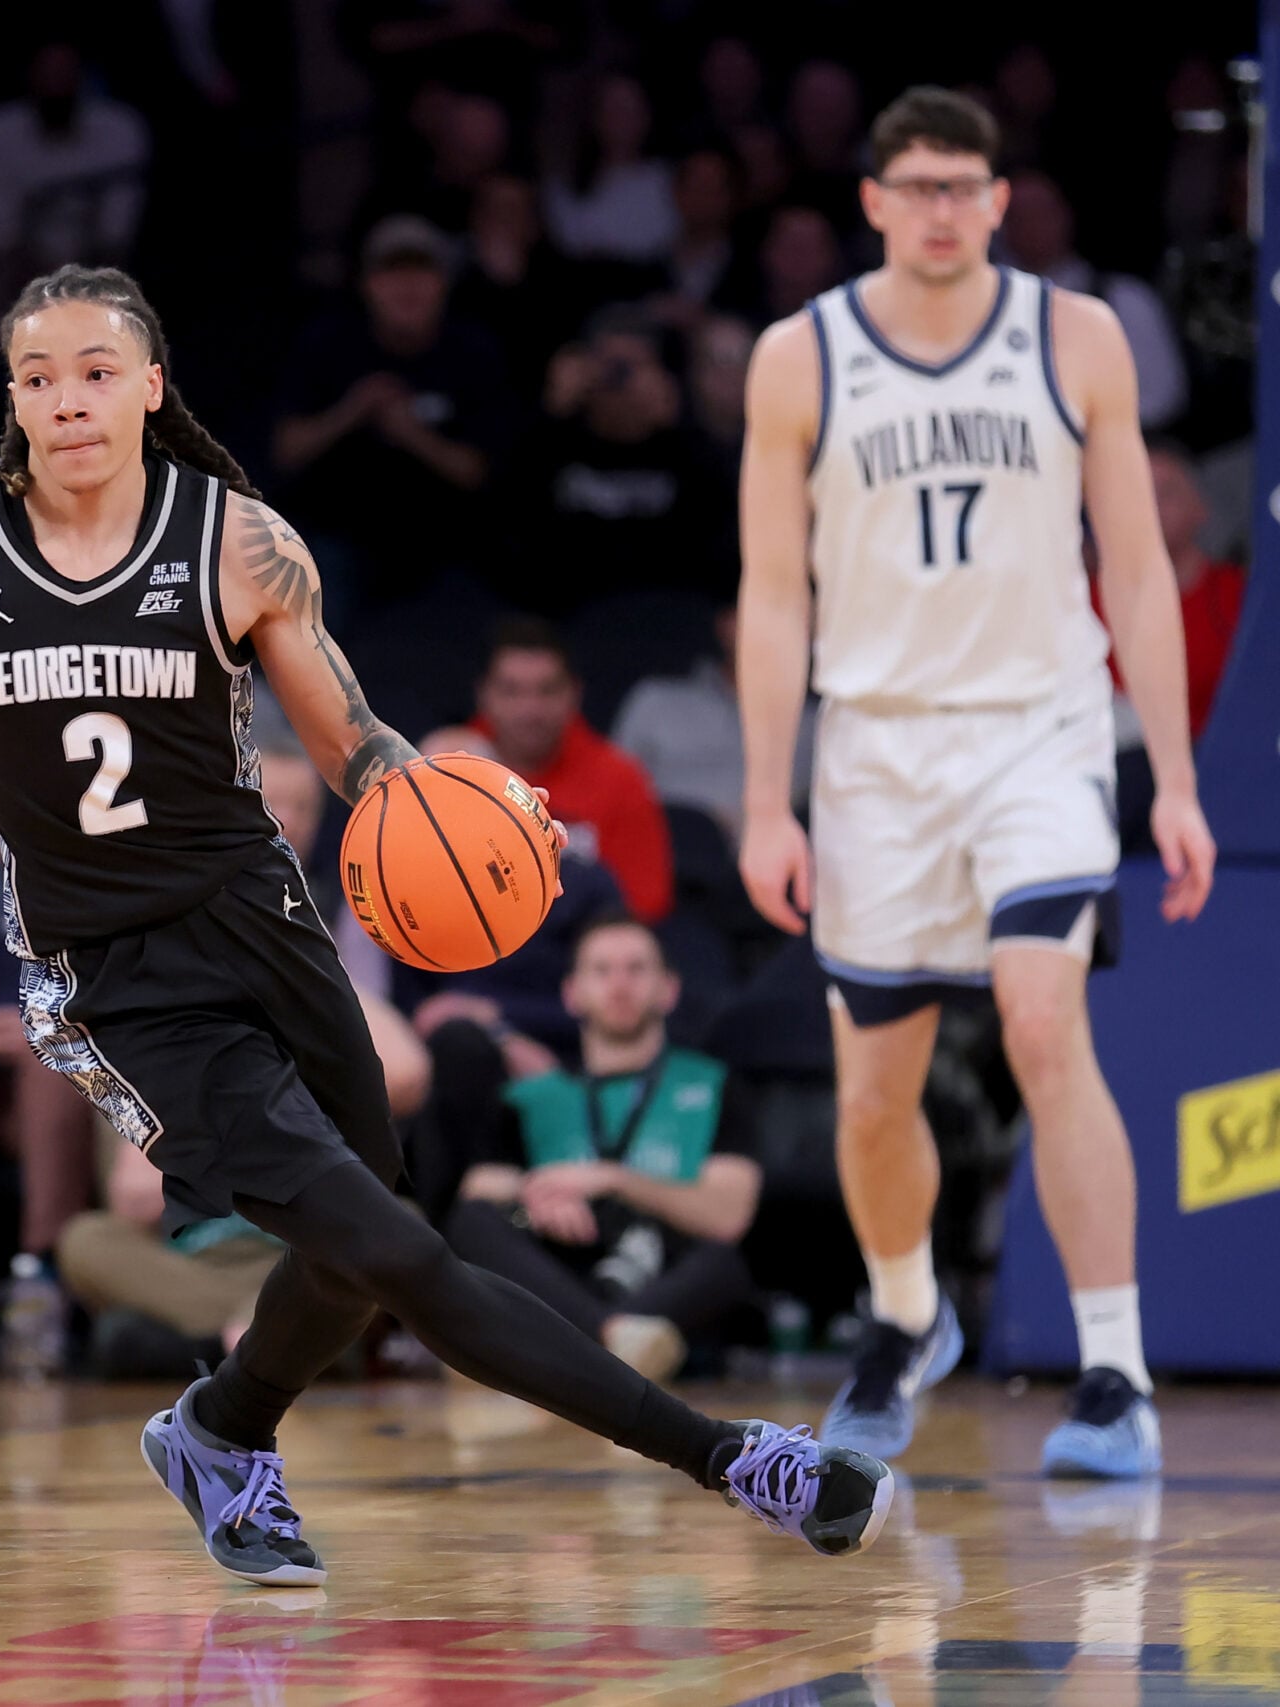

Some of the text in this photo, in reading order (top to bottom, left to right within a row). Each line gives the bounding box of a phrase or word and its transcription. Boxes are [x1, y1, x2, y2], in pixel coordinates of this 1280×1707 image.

[852, 408, 1040, 489] VILLANOVA
[919, 481, 984, 567] 17
[153, 561, 189, 575] BE THE
[149, 572, 191, 586] CHANGE
[143, 590, 176, 603] BIG
[138, 599, 184, 612] EAST
[61, 711, 149, 837] 2
